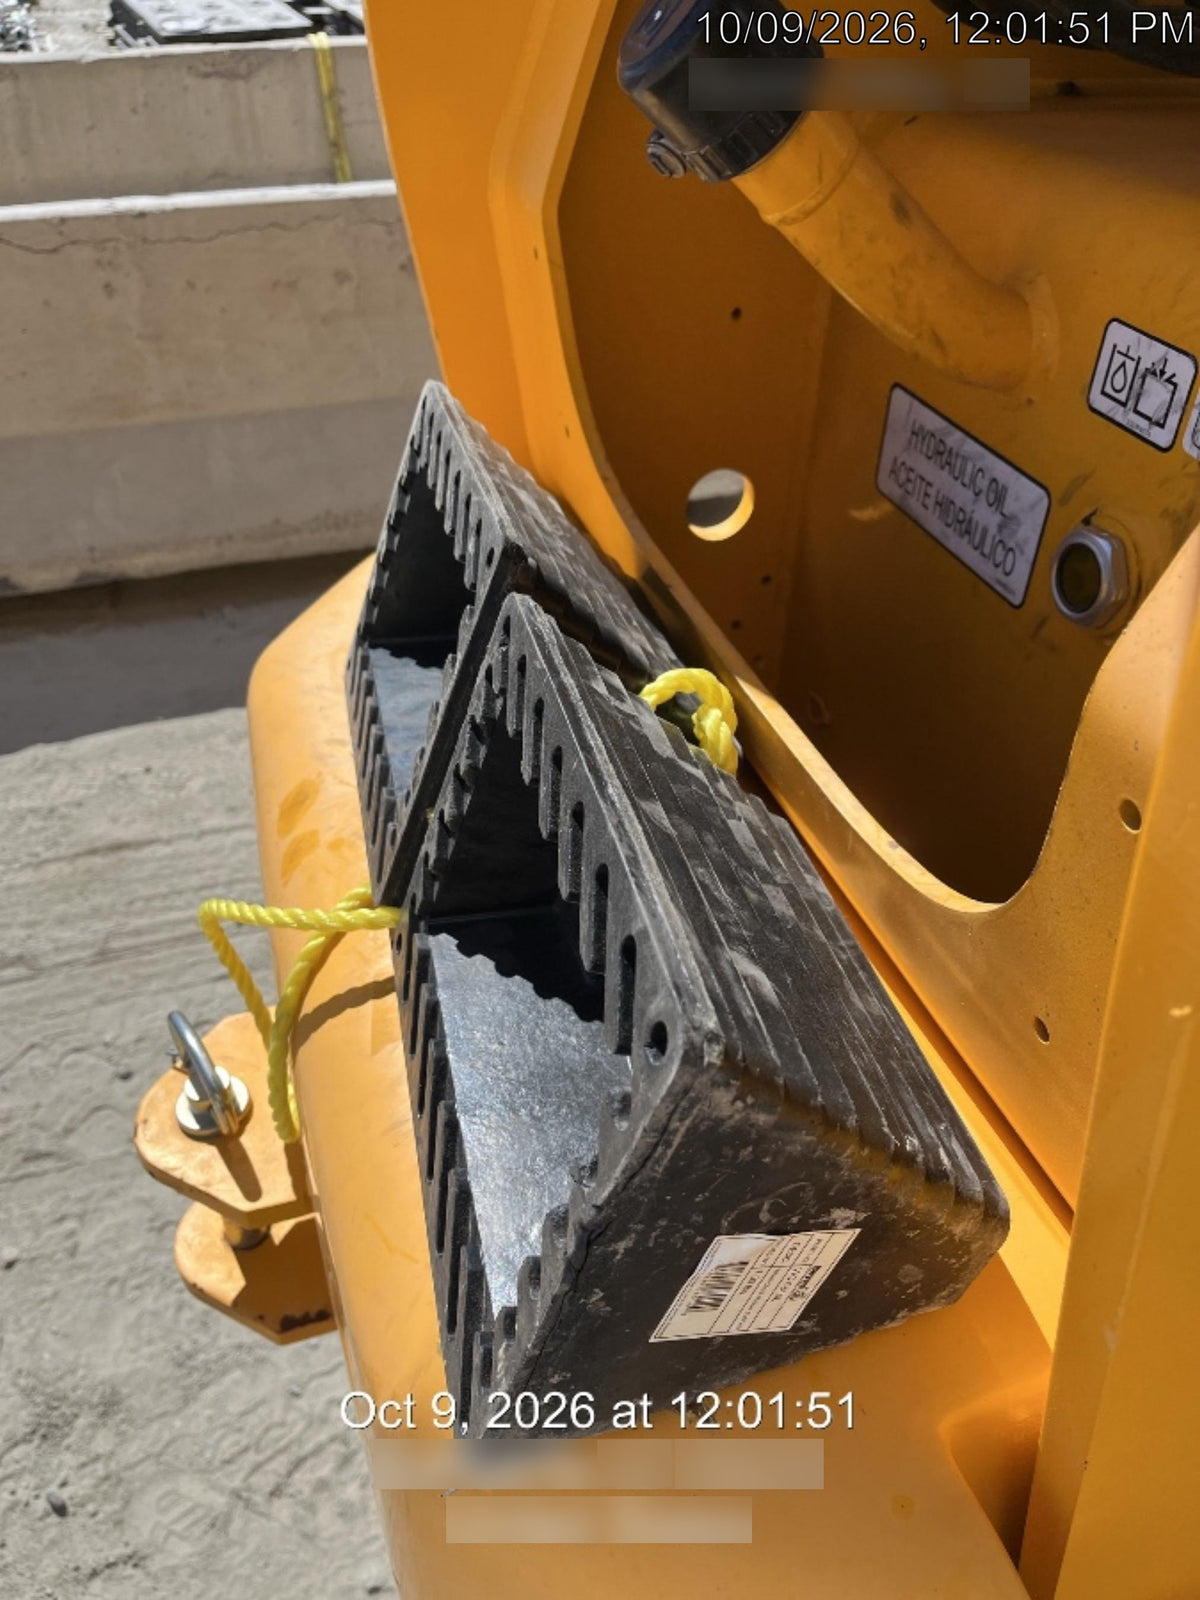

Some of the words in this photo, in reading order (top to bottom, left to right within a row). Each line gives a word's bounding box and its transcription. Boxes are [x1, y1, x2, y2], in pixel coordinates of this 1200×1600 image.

[889, 456, 933, 511] ACEITE
[908, 421, 985, 497] HYDRAULIC
[986, 477, 1010, 518] OIL
